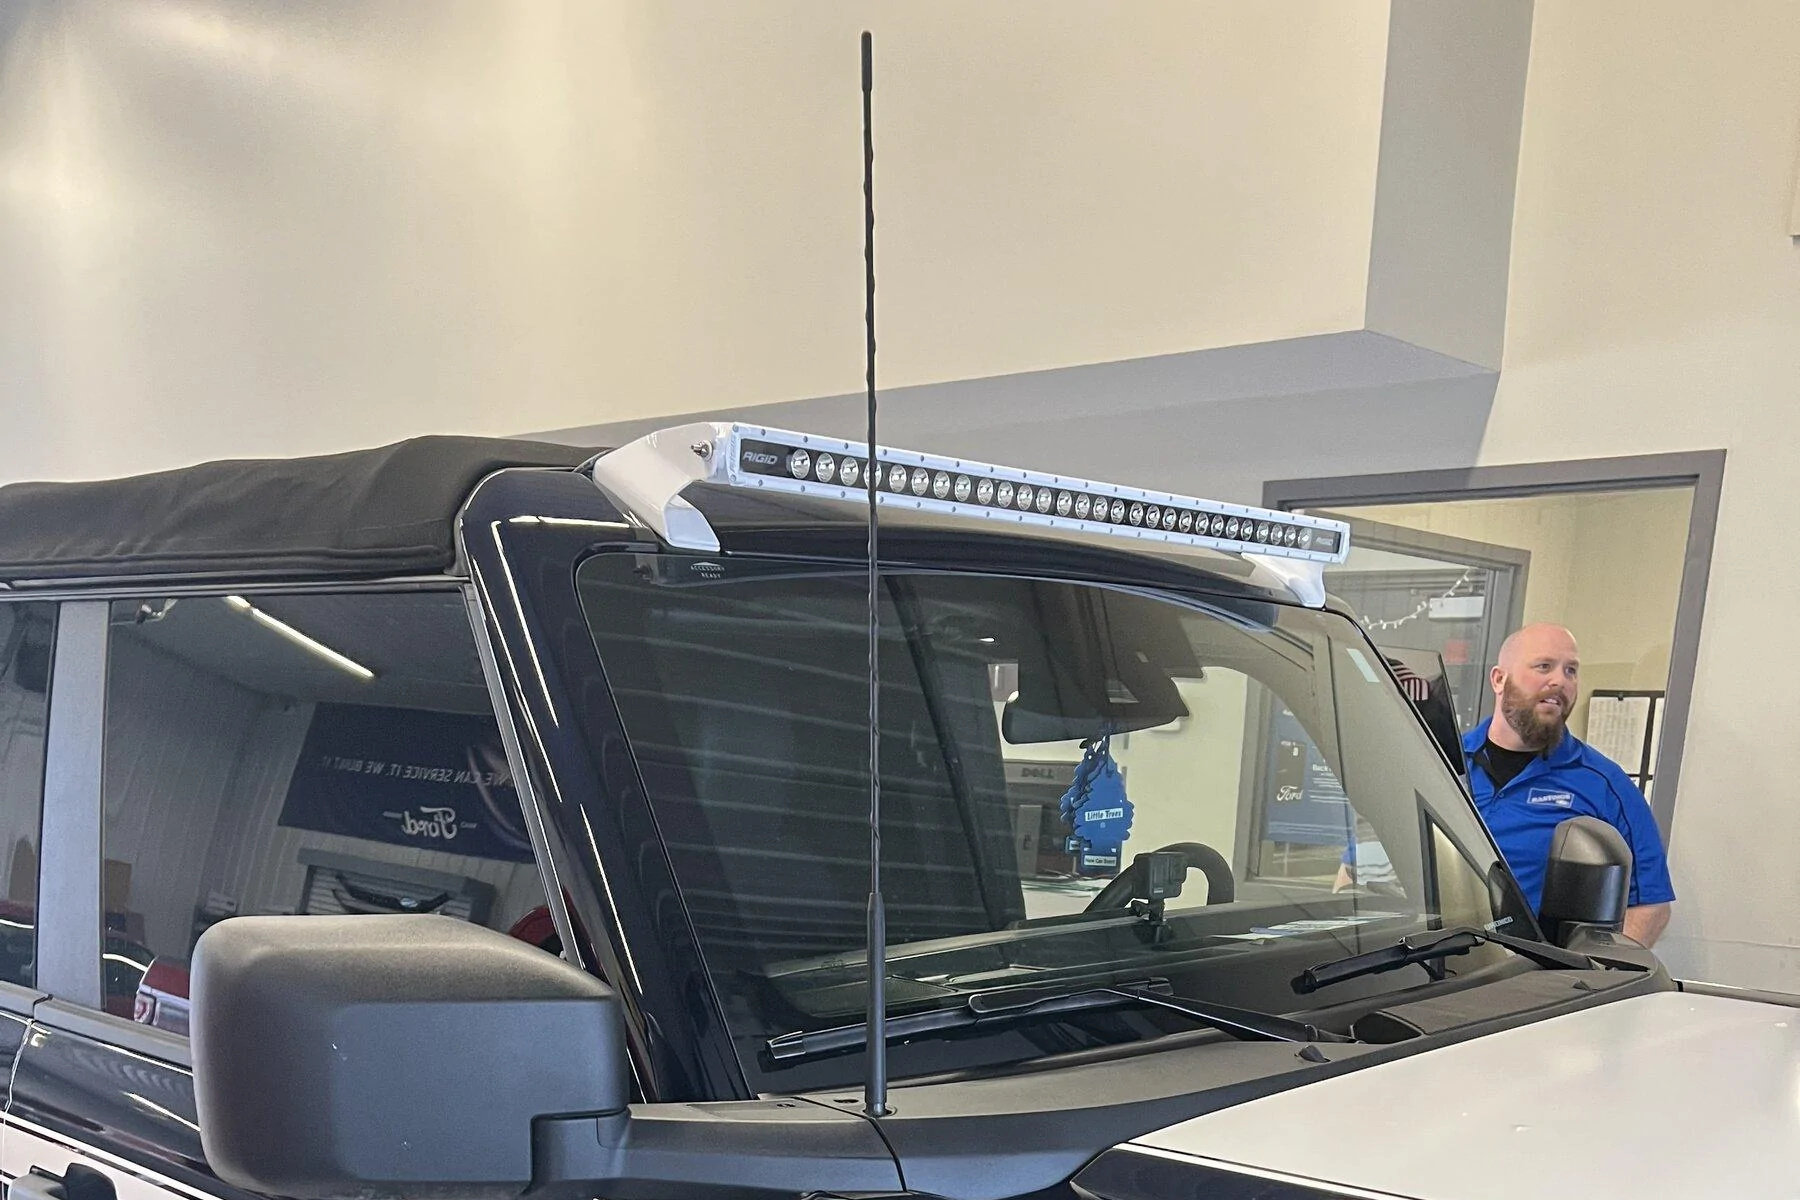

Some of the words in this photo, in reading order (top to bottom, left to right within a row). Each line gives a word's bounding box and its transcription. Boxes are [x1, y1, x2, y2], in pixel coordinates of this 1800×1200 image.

[742, 451, 778, 465] RIGID
[1021, 767, 1055, 779] DELL
[1276, 785, 1304, 801] Ford
[1087, 811, 1104, 820] Little
[1105, 809, 1122, 818] Trees
